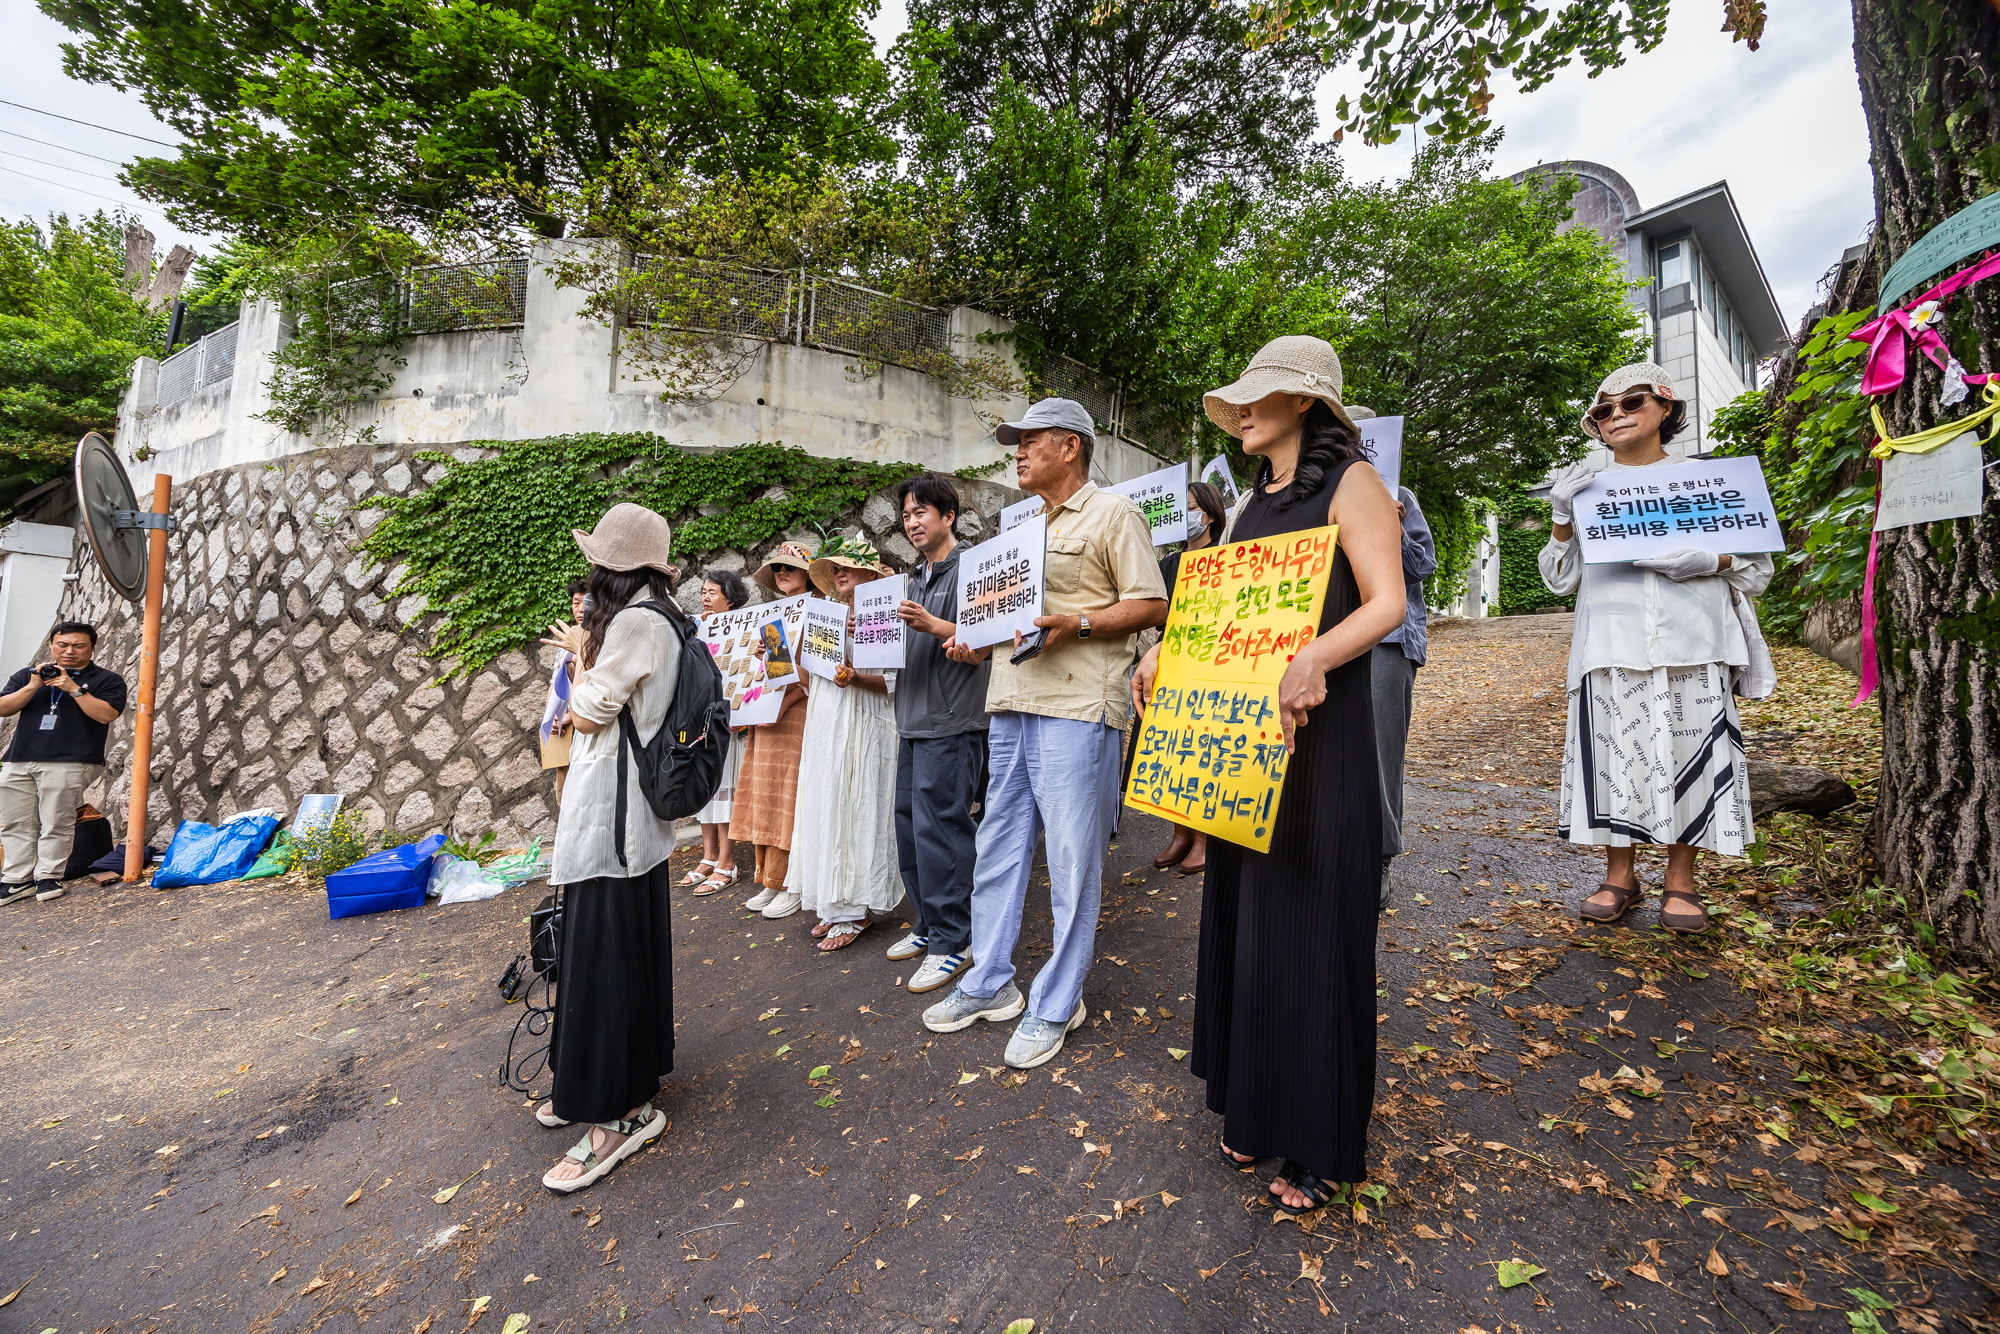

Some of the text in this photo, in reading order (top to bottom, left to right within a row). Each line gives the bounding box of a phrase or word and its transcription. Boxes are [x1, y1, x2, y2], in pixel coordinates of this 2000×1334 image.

[1127, 485, 1162, 500] 행나무 독살
[1606, 478, 1726, 498] 죽어가는 은행나무
[1596, 490, 1746, 520] 환기미술관은
[1910, 496, 1916, 508] 꼭
[1014, 511, 1030, 522] 은행나무
[1586, 512, 1768, 541] 회복비용 부담하라
[978, 547, 1018, 574] 은행나무 독살
[1180, 534, 1330, 590] 부암동 은행나무님
[966, 559, 1030, 602] 환기미술관은
[784, 599, 804, 624] 마음
[884, 595, 892, 604] 그만
[960, 585, 1037, 626] 책임있게 복원하라
[1176, 577, 1314, 622] 나무와 살던 모든
[808, 622, 840, 646] 환기미술관은
[876, 627, 902, 644] 지정하라
[803, 640, 843, 664] 은행나무 살려내라
[1150, 686, 1183, 718] 우리
[1673, 692, 1684, 722] edition
[1140, 724, 1288, 782] 오래 부암동을 지킨
[1632, 740, 1649, 767] edition
[1133, 756, 1274, 838] 은행나무입니다!
